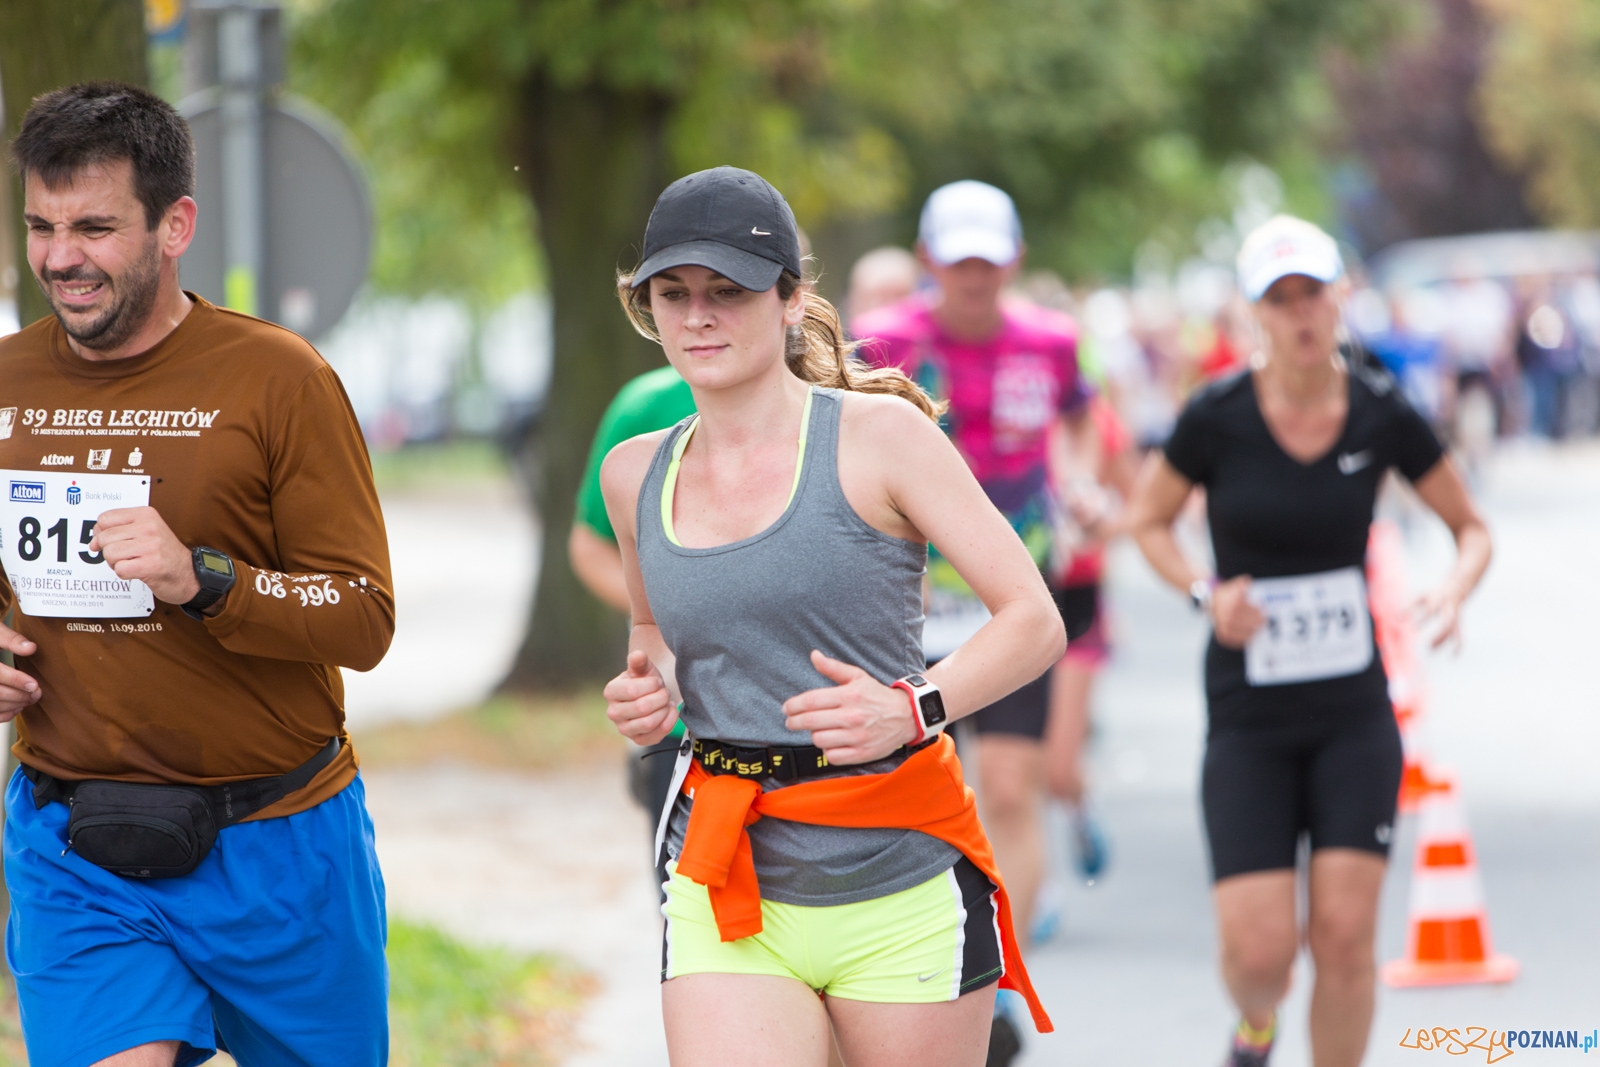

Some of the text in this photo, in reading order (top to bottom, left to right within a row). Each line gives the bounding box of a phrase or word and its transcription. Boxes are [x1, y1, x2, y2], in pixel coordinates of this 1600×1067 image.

[22, 408, 47, 427] 39
[52, 409, 103, 427] BIEG
[107, 407, 220, 428] LECHITÓW
[31, 428, 40, 436] 19
[85, 428, 108, 436] POLSKI
[109, 428, 140, 437] LEKARZY
[141, 428, 149, 437] W
[85, 491, 122, 501] Bank Polski
[18, 516, 105, 565] 815
[47, 568, 72, 576] MARCIN
[21, 577, 32, 590] 39
[35, 578, 62, 591] BIEG
[66, 578, 131, 592] LECHITÓW
